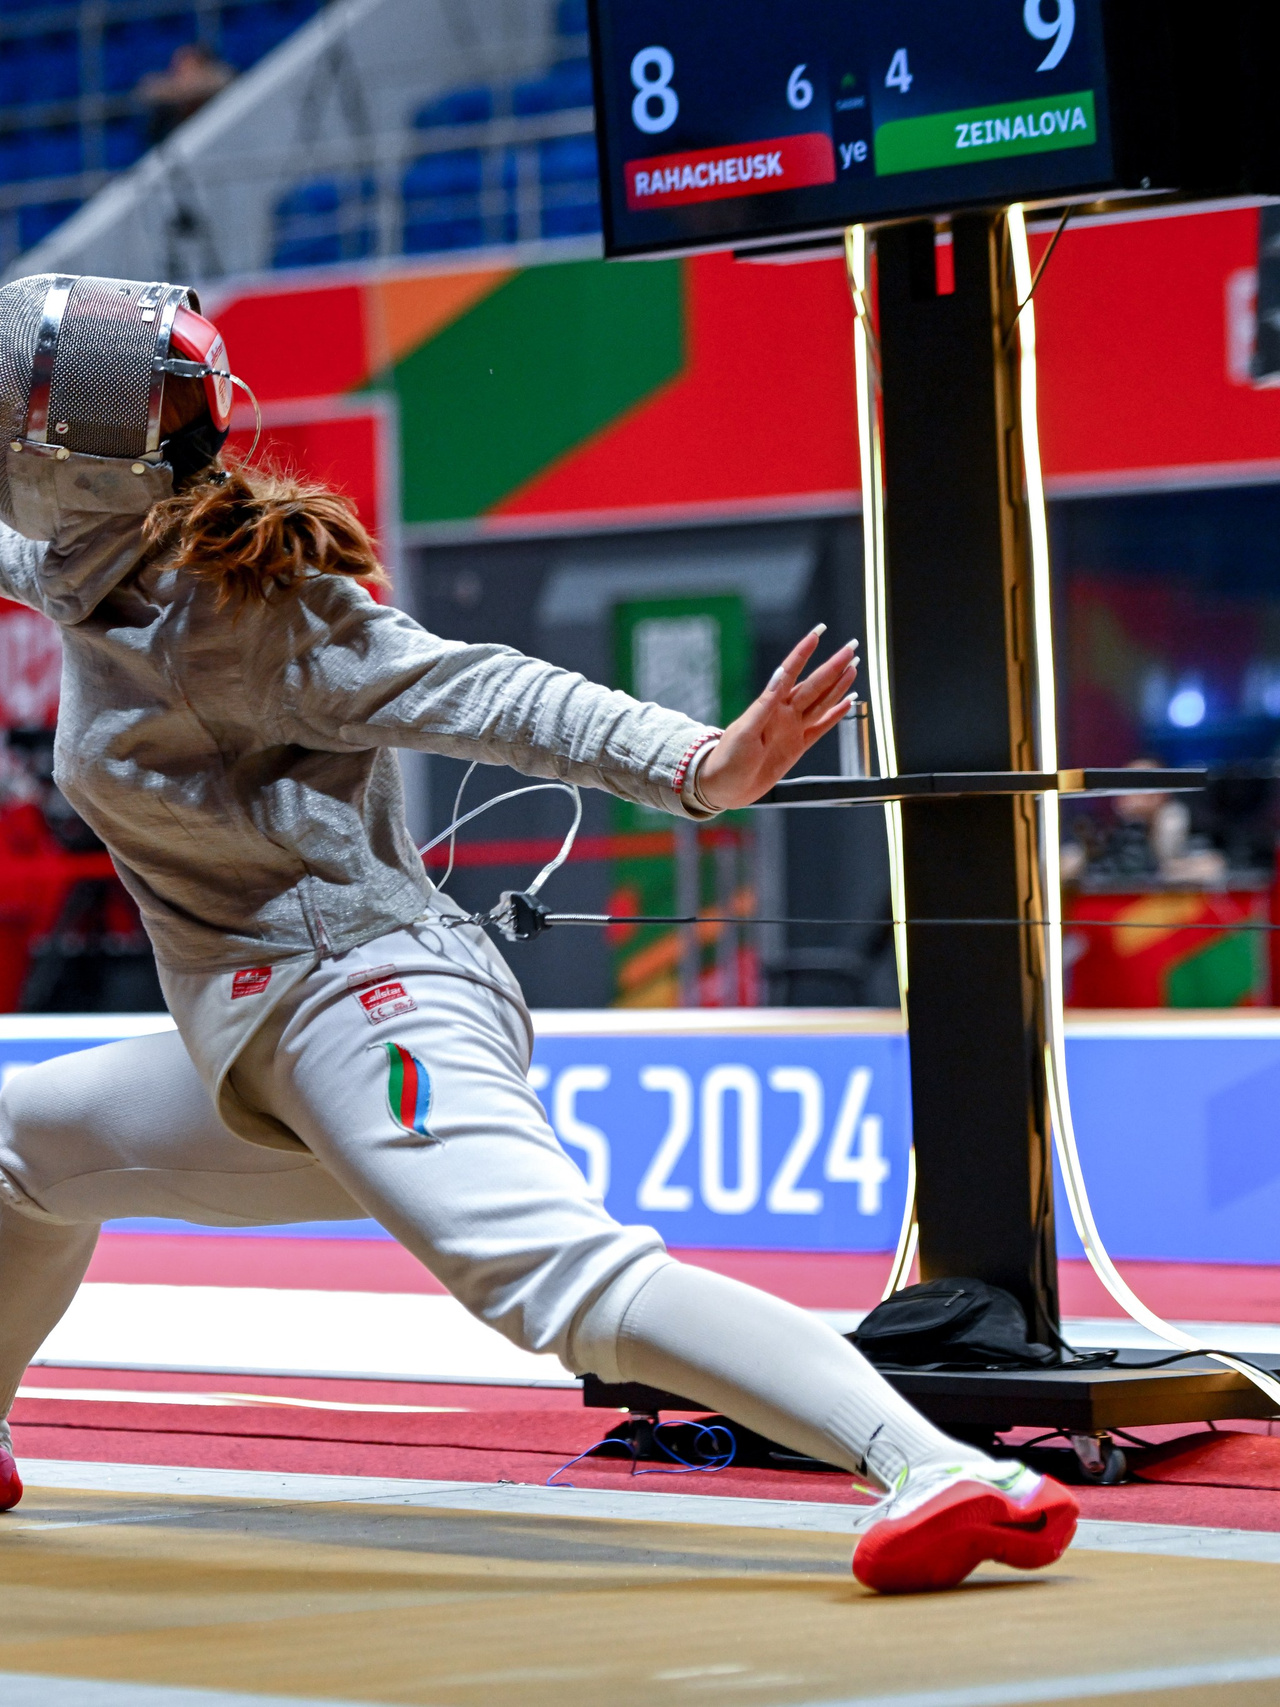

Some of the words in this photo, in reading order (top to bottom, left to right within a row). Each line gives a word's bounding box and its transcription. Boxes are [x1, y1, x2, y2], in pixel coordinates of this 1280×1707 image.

[1023, 0, 1076, 73] 9
[629, 45, 680, 135] 8
[786, 63, 814, 110] 6
[885, 47, 913, 94] 4
[955, 105, 1088, 149] ZEINALOVA
[634, 151, 784, 197] RAHACHEUSK
[839, 140, 868, 170] ye
[364, 987, 402, 1004] allstar
[636, 1063, 891, 1216] 2024
